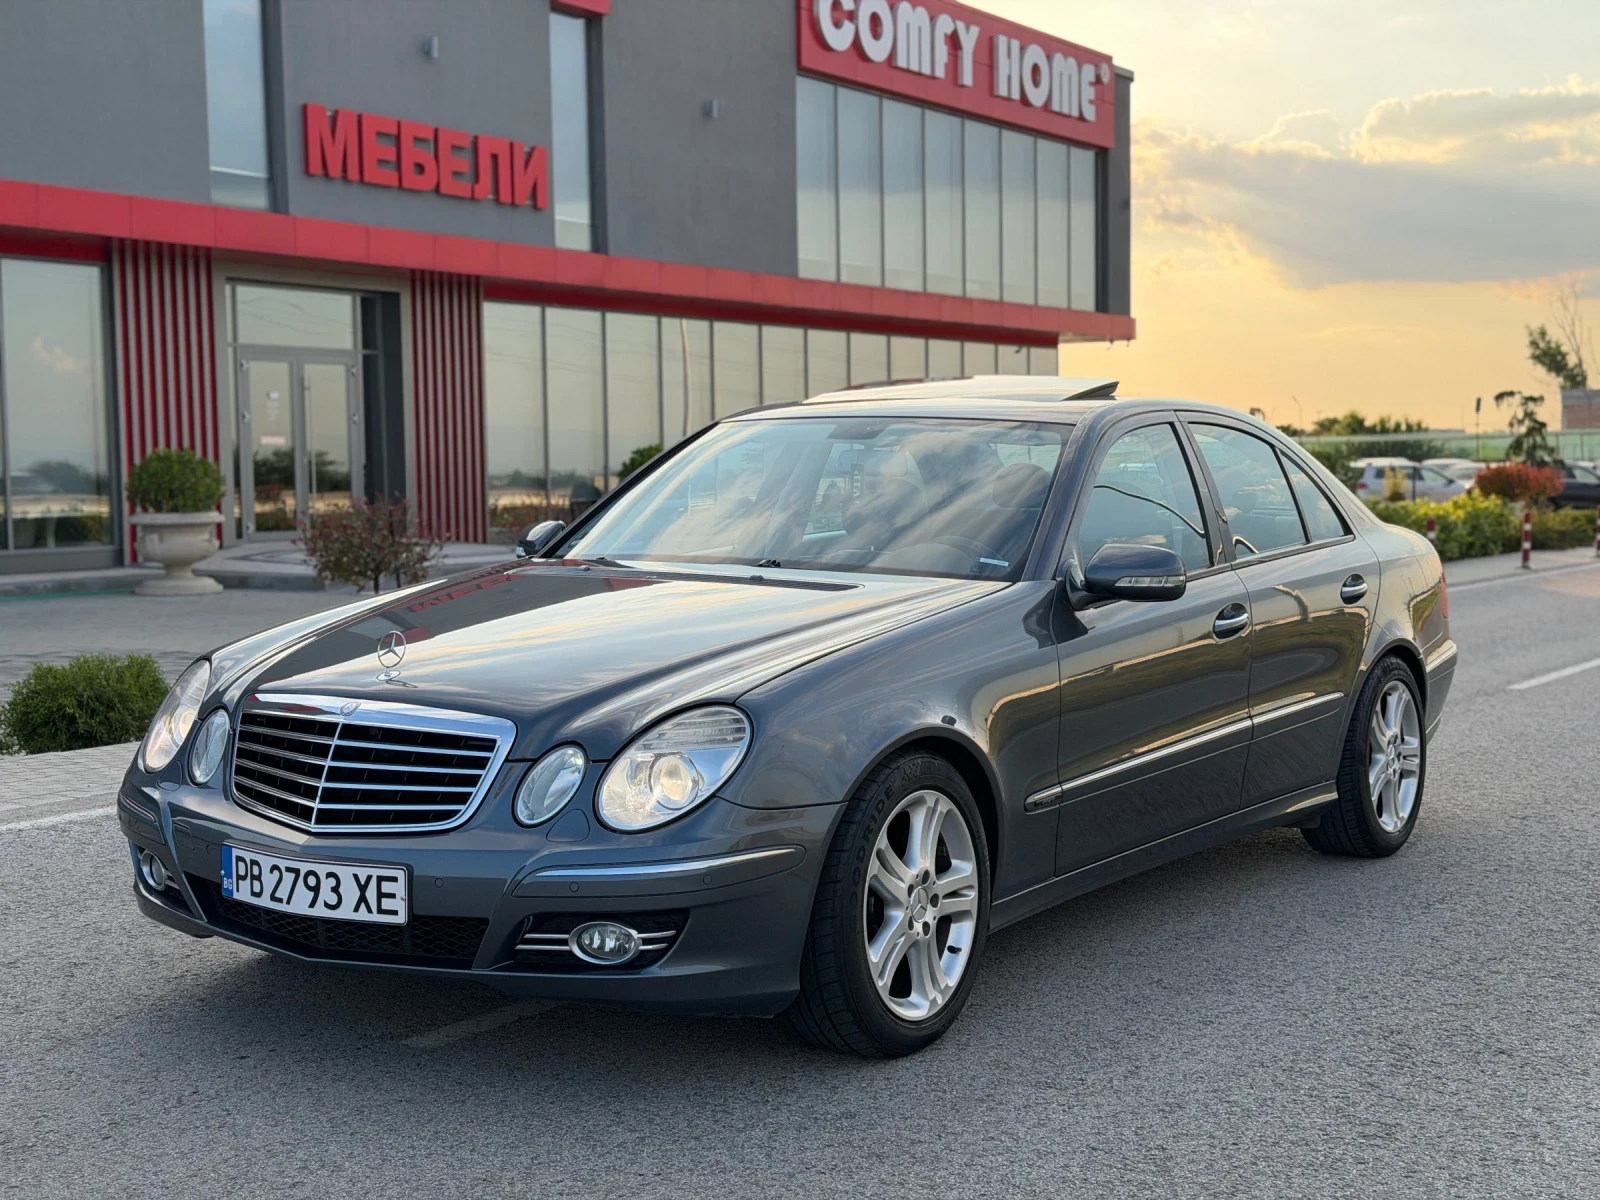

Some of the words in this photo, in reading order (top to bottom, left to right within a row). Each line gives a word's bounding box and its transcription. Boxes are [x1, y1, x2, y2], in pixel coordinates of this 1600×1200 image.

[816, 0, 980, 87] COMFY
[992, 34, 1096, 122] HOME
[303, 102, 548, 210] МЕБЕЛИ
[223, 877, 233, 890] BG
